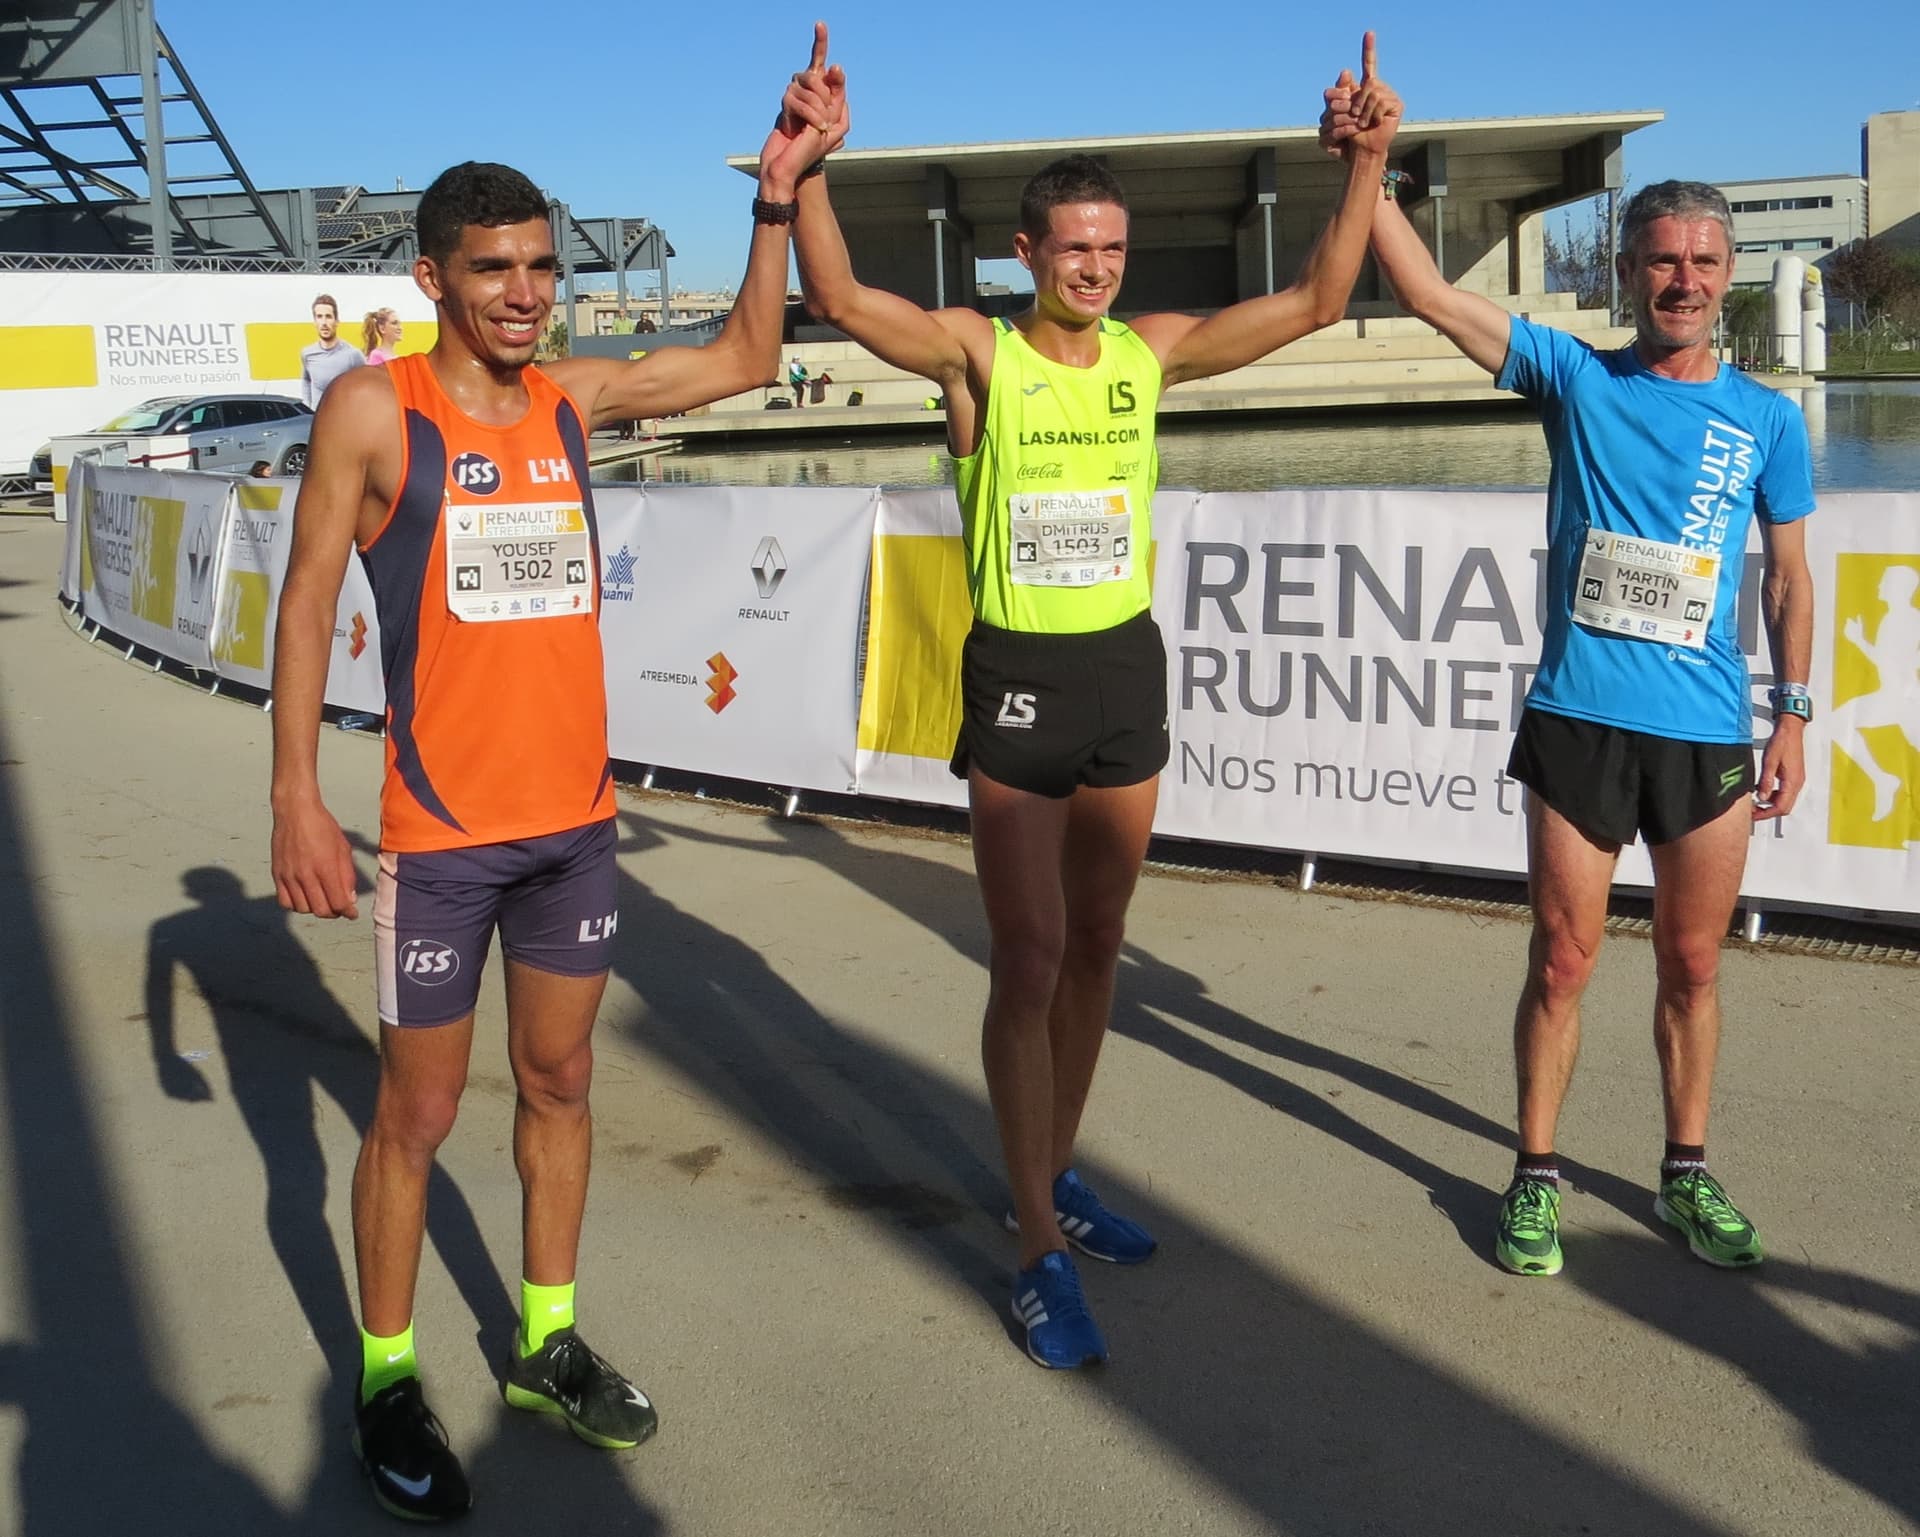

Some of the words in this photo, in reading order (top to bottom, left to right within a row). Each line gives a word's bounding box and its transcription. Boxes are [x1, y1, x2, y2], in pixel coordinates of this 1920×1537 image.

[104, 323, 235, 348] RENAULT
[107, 347, 239, 368] RUNNERS.ES
[110, 373, 137, 386] Nos
[139, 374, 182, 385] mueve
[183, 372, 198, 384] tu
[200, 370, 241, 386] pasión
[1108, 380, 1136, 414] LS
[1019, 428, 1140, 447] LASANSI.COM
[1727, 441, 1754, 497] RUN
[1678, 429, 1731, 552] ENAULT
[1040, 498, 1103, 511] RENAULT
[1040, 511, 1078, 519] STREET
[1080, 509, 1104, 518] RUN
[486, 510, 554, 525] RENAULT
[486, 526, 527, 537] STREET
[530, 525, 554, 535] RUN
[492, 541, 558, 558] YOUSEF
[1053, 538, 1101, 556] 1503
[1615, 540, 1683, 563] RENAULT
[500, 559, 553, 581] 1502
[1614, 552, 1656, 568] STREET
[1659, 560, 1682, 573] RUN
[1616, 567, 1680, 591] MARTÍN
[1619, 584, 1671, 609] 1501
[738, 608, 790, 622] RENAULT
[640, 669, 698, 686] ATRESMEDIA
[997, 692, 1037, 724] LS
[1180, 740, 1276, 793] Nos
[1294, 762, 1477, 812] mueve
